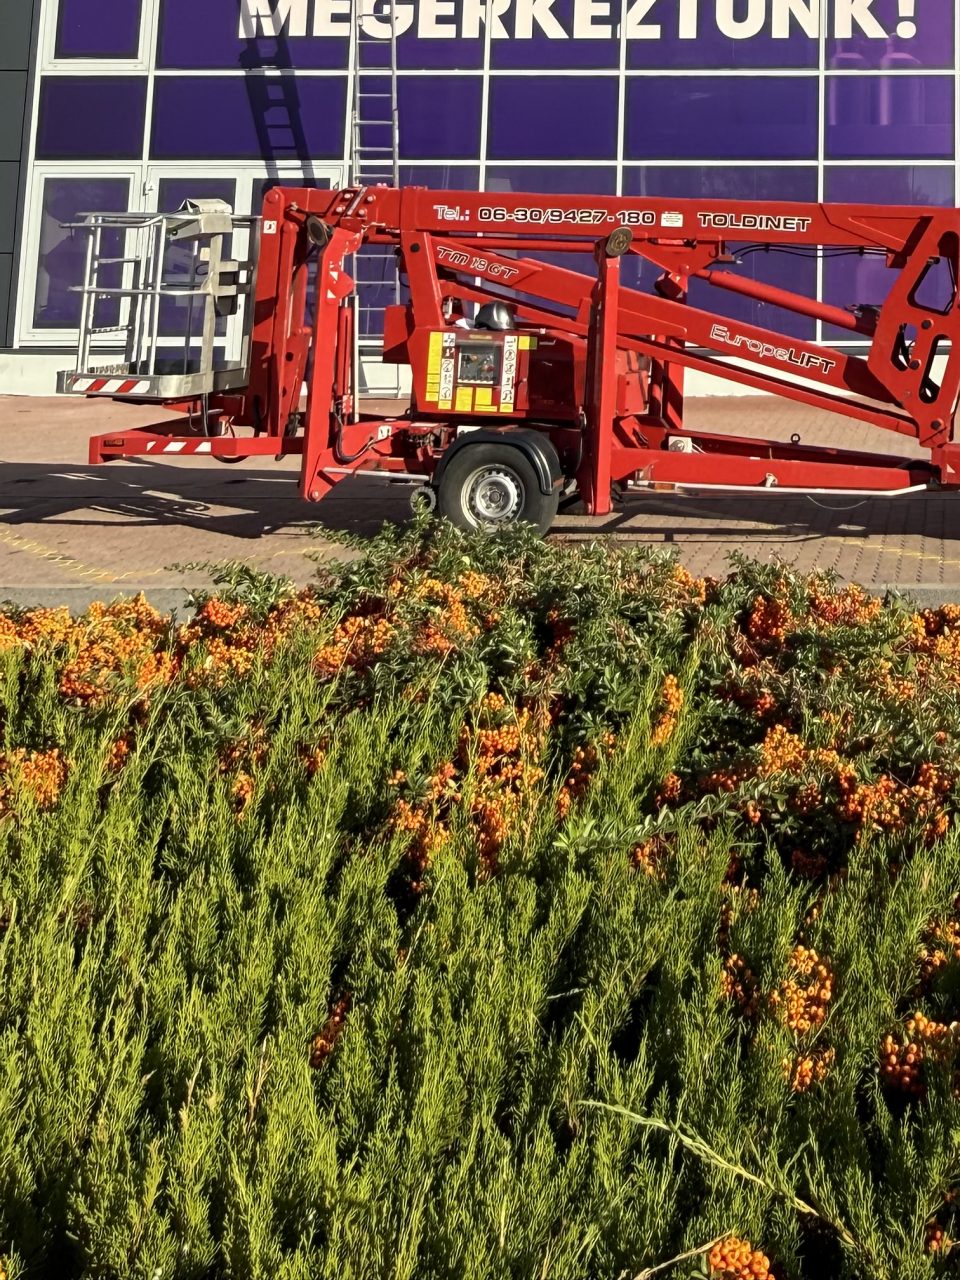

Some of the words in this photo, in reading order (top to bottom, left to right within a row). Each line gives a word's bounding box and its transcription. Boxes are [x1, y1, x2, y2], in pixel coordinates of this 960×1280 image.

[433, 204, 471, 222] Tel.:
[477, 206, 656, 227] 06-30/9427-180
[698, 211, 812, 232] TOLDINET
[437, 246, 469, 265] TM
[471, 257, 487, 271] 18
[488, 262, 519, 279] GT
[709, 324, 836, 374] EuropeLIFT
